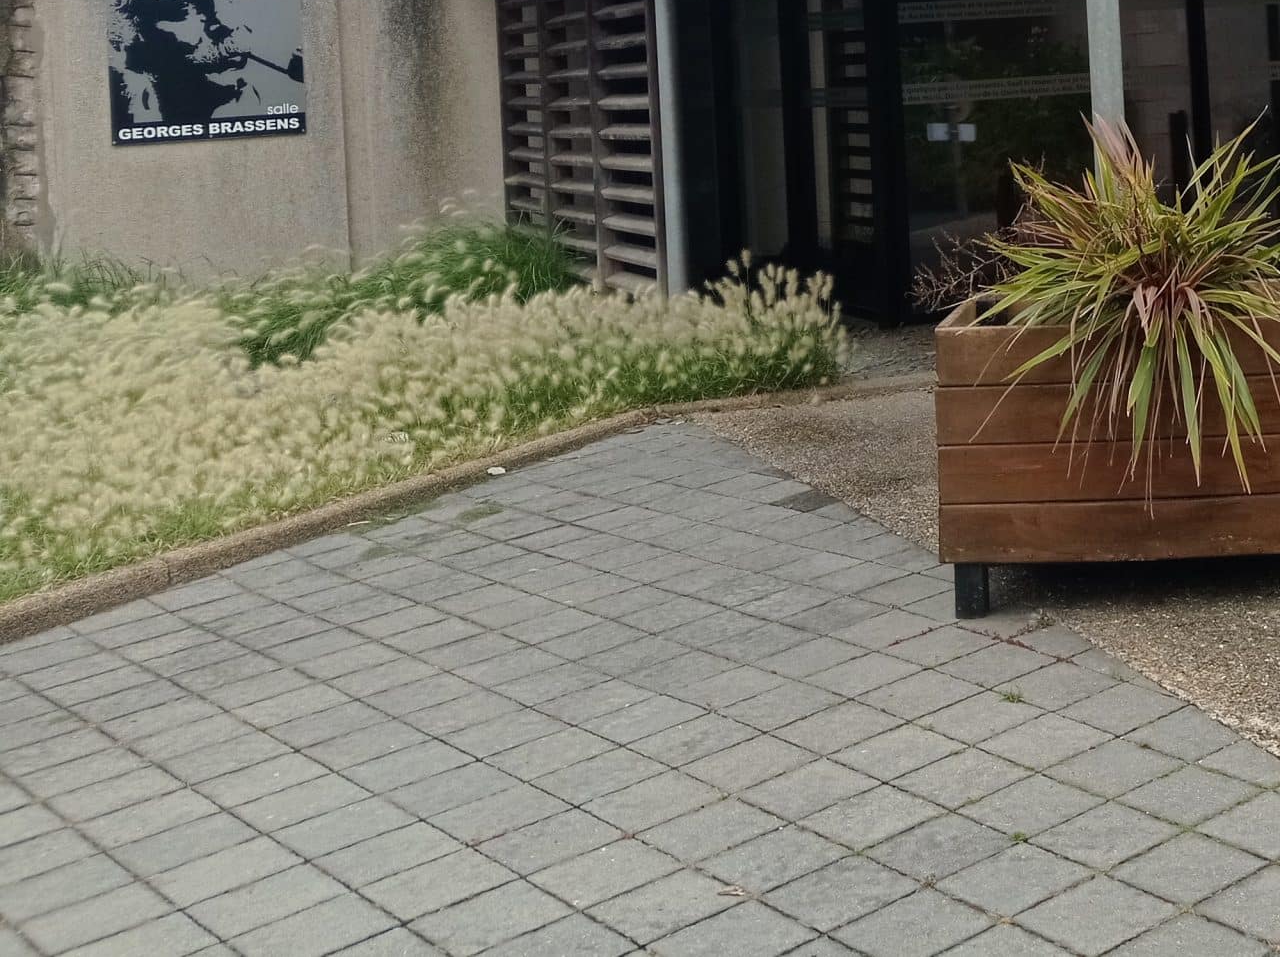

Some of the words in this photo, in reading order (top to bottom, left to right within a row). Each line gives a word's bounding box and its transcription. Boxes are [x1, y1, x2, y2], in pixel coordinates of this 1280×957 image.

[267, 103, 299, 115] salle
[118, 124, 203, 140] GEORGES
[208, 117, 300, 135] BRASSENS
